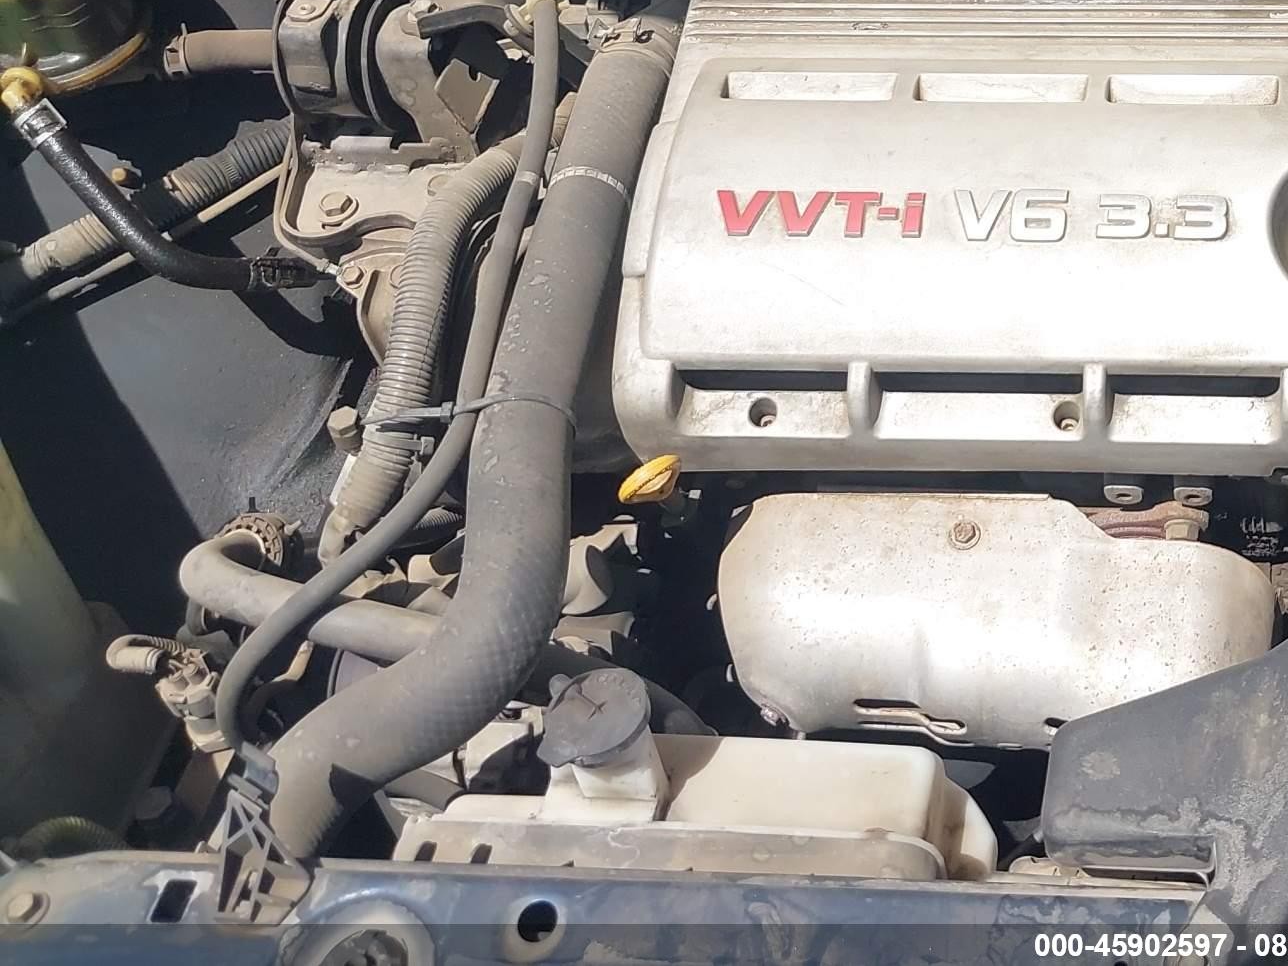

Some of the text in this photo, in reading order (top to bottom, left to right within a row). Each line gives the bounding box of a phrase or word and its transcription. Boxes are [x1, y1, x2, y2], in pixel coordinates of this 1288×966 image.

[717, 188, 1233, 243] VVT-i V6 3.3
